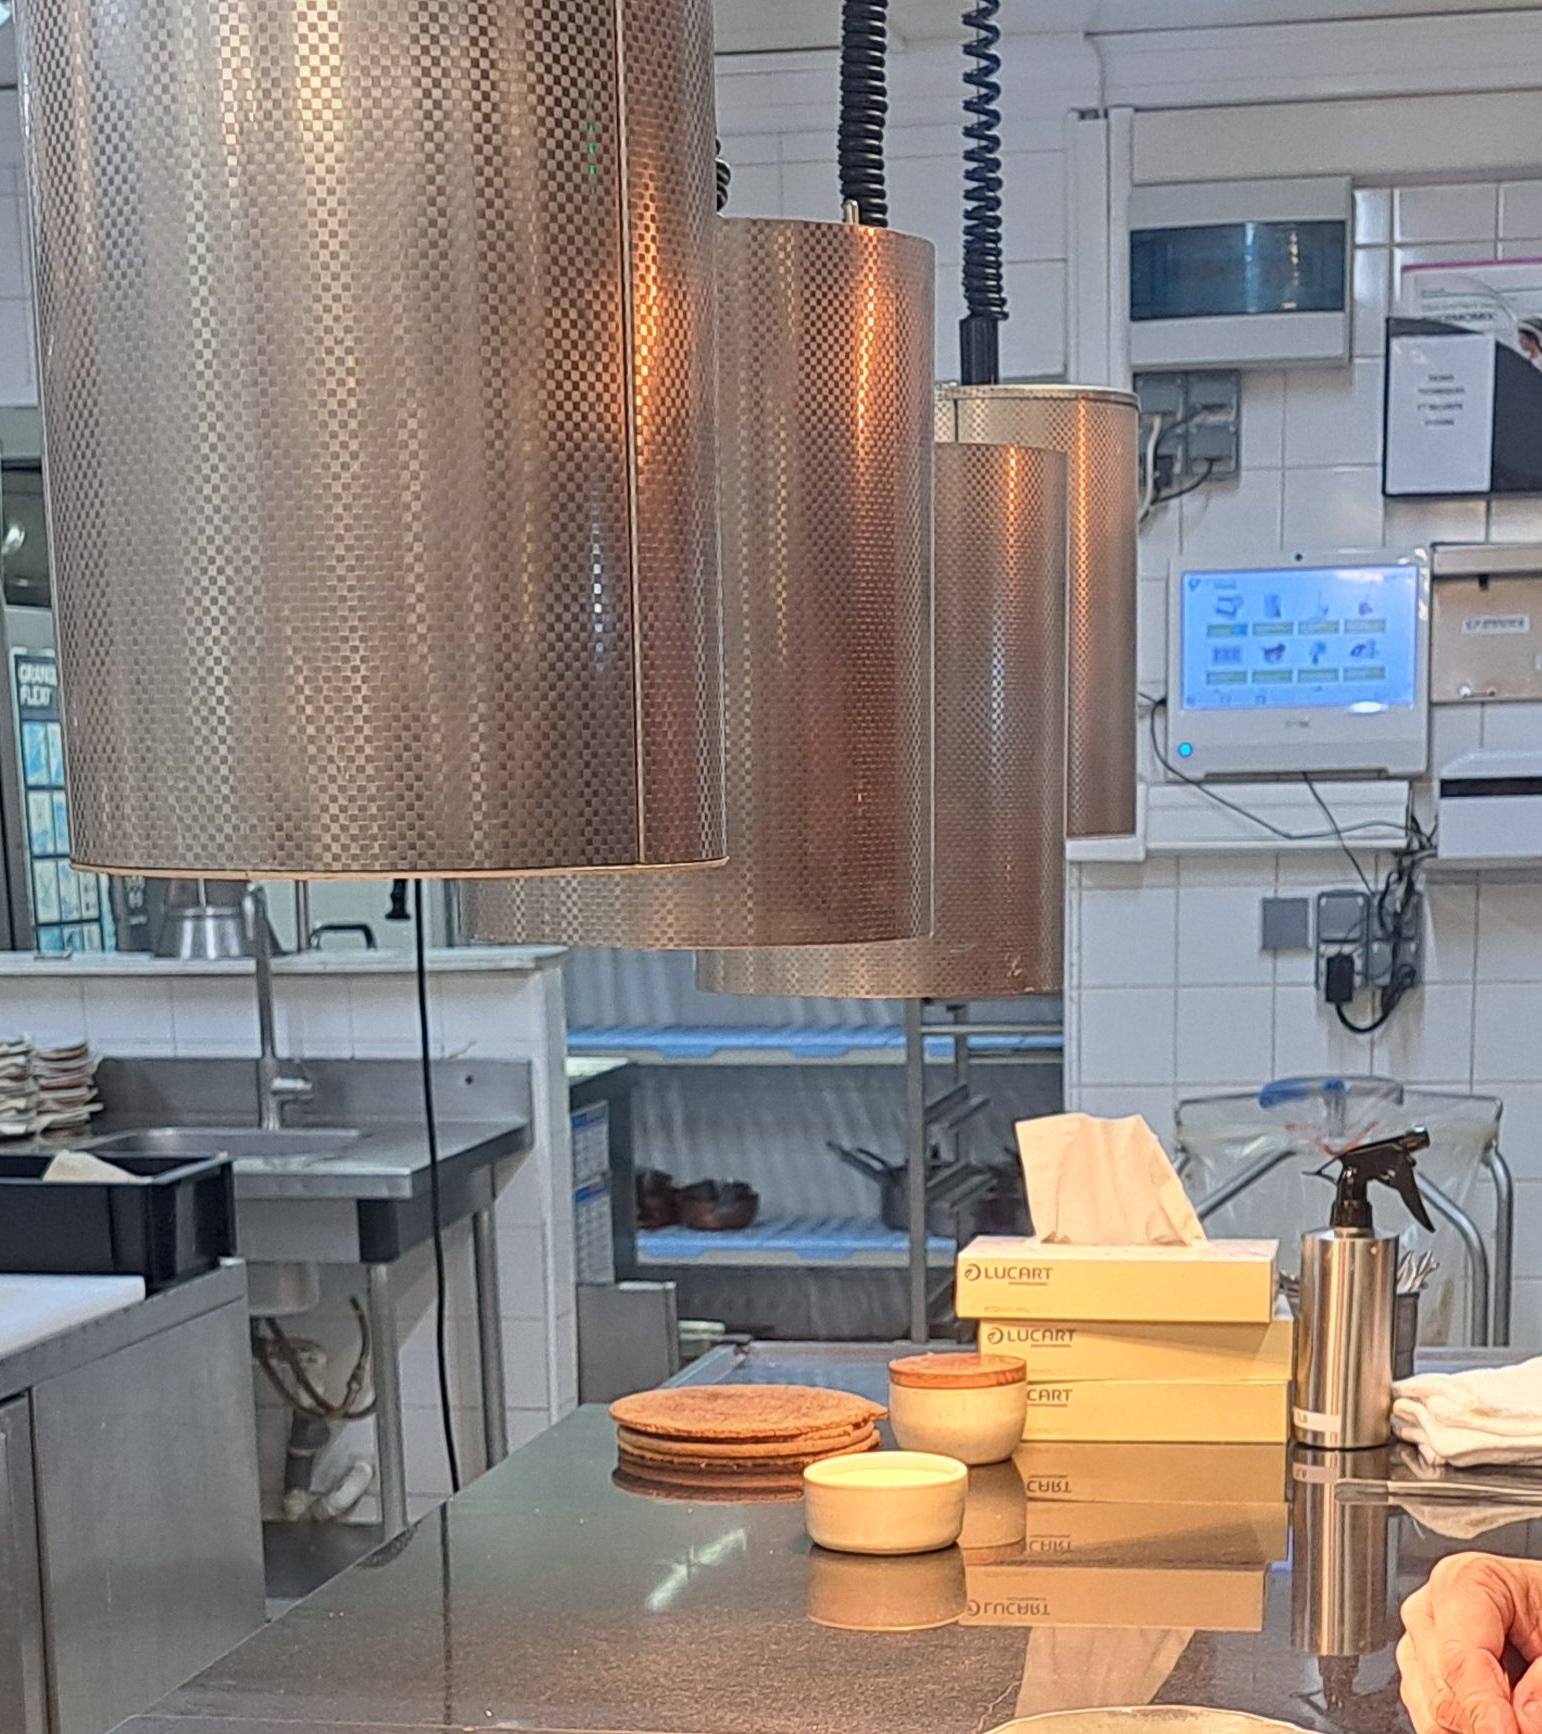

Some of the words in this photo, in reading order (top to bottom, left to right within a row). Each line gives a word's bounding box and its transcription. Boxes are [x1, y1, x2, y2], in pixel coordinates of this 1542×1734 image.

[985, 1267, 1053, 1280] LUCART
[1007, 1328, 1076, 1342] LUCART
[1027, 1389, 1073, 1401] CART
